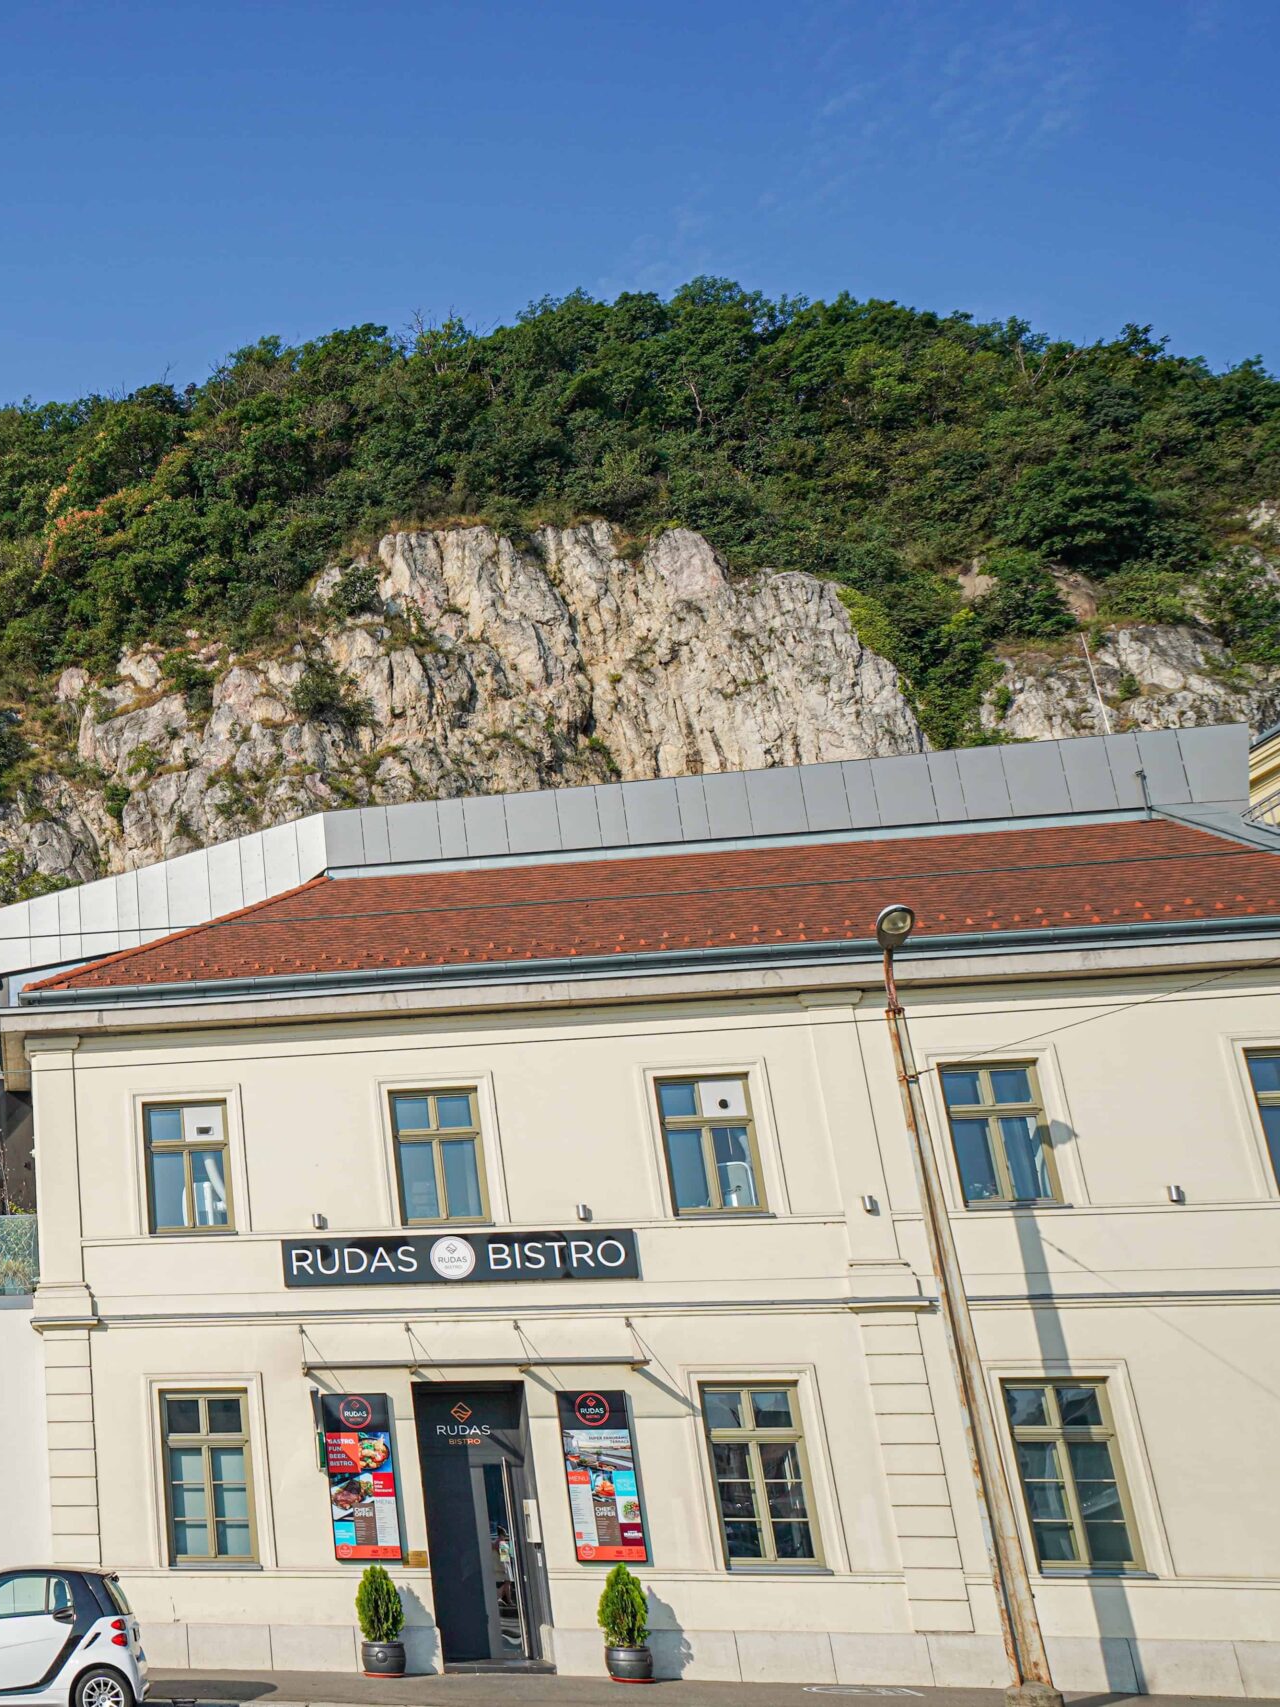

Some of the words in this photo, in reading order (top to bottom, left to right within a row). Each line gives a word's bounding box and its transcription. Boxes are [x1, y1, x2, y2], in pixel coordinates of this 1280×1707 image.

[291, 1246, 418, 1275] RUDAS
[487, 1239, 626, 1270] BISTRO
[436, 1424, 491, 1435] RUDAS
